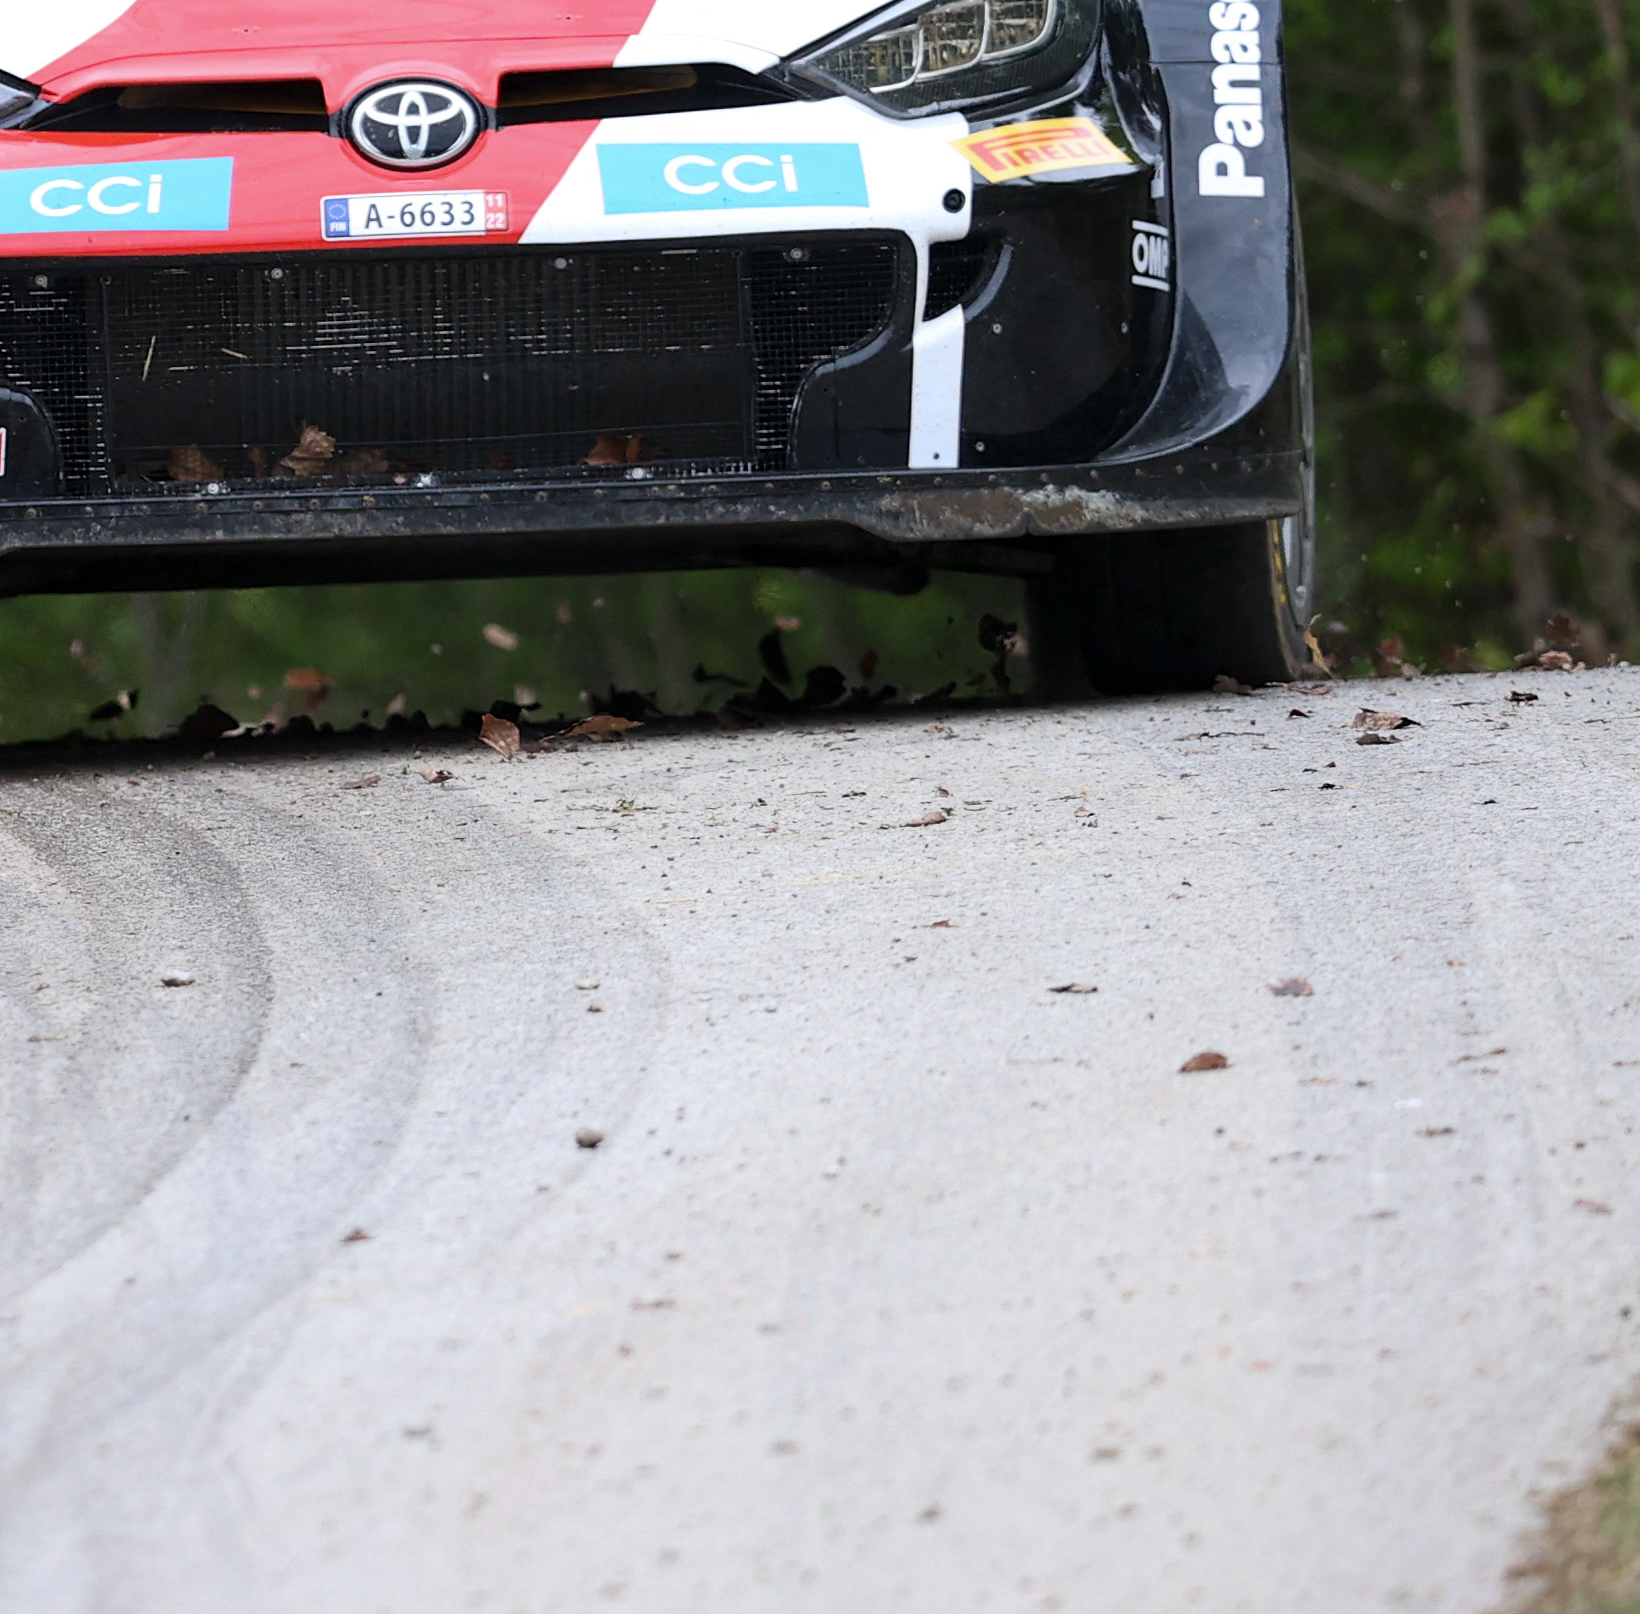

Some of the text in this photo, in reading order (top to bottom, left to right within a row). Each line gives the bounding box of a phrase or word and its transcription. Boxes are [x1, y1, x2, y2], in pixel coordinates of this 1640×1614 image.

[966, 126, 1112, 172] PIRELLI
[486, 193, 504, 207] 11
[364, 200, 476, 230] A-6633
[486, 212, 505, 229] 22
[329, 221, 347, 233] FIN
[1131, 232, 1169, 279] OMP
